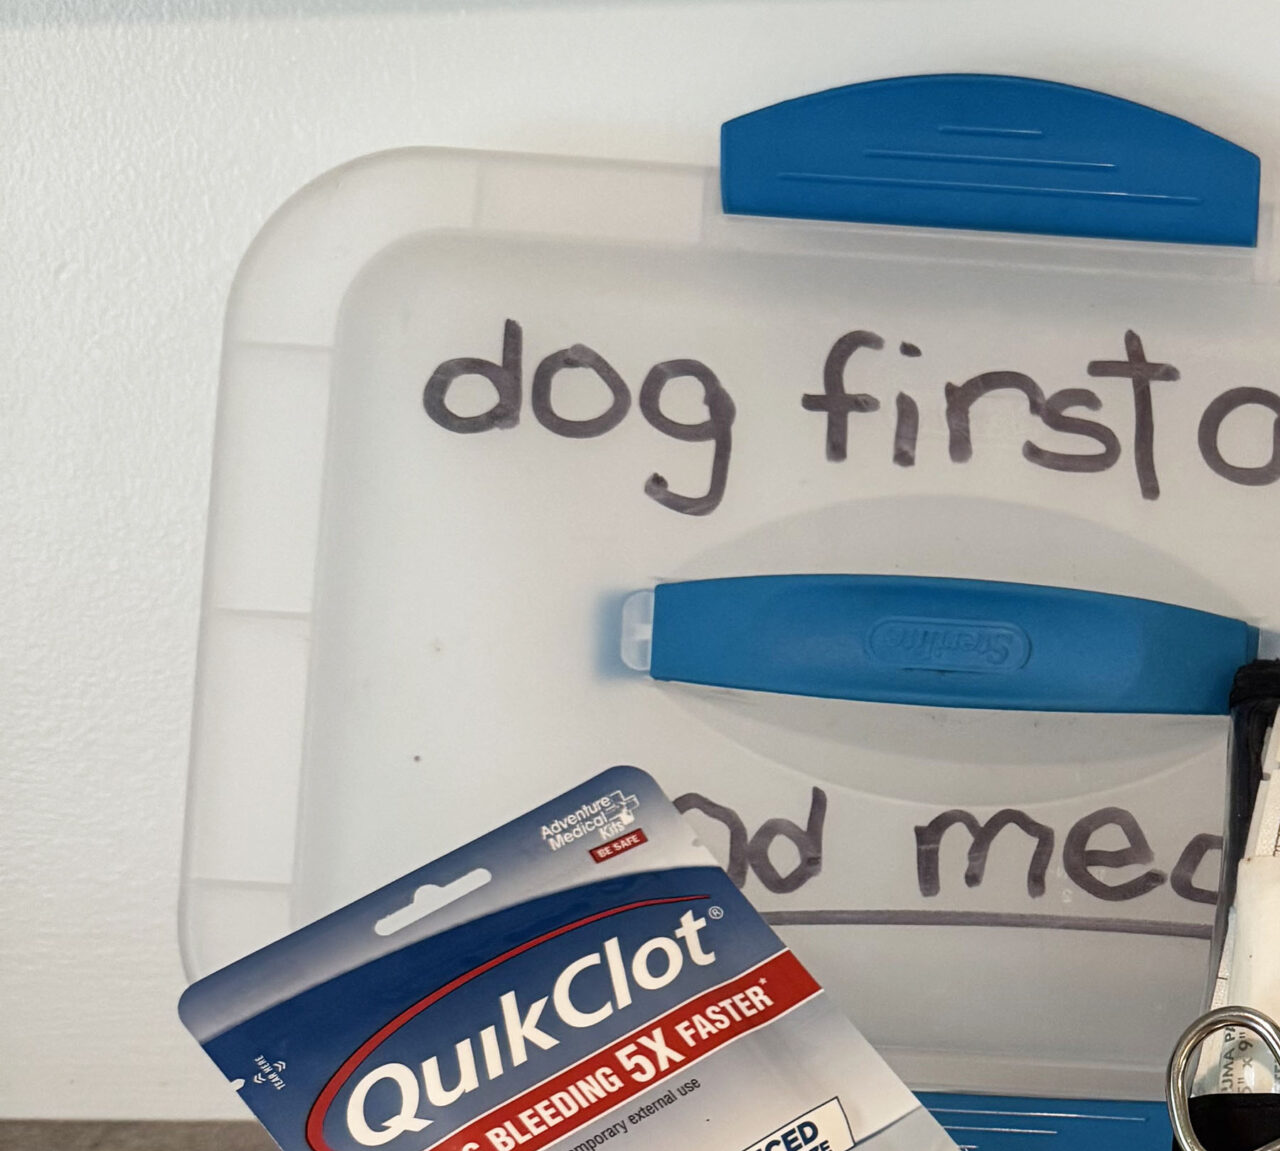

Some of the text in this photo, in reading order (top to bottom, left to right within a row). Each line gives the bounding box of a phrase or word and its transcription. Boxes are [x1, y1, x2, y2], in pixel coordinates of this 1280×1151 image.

[423, 318, 736, 516] dog
[800, 329, 1183, 500] first
[541, 795, 611, 840] Adventure
[547, 811, 608, 852] Medical
[598, 819, 626, 841] Kits
[672, 786, 827, 894] nd
[597, 833, 641, 859] BE SAFE
[618, 1033, 687, 1084] 5X
[1238, 1031, 1254, 1052] 9"
[628, 1091, 678, 1126] external
[675, 1076, 702, 1101] use
